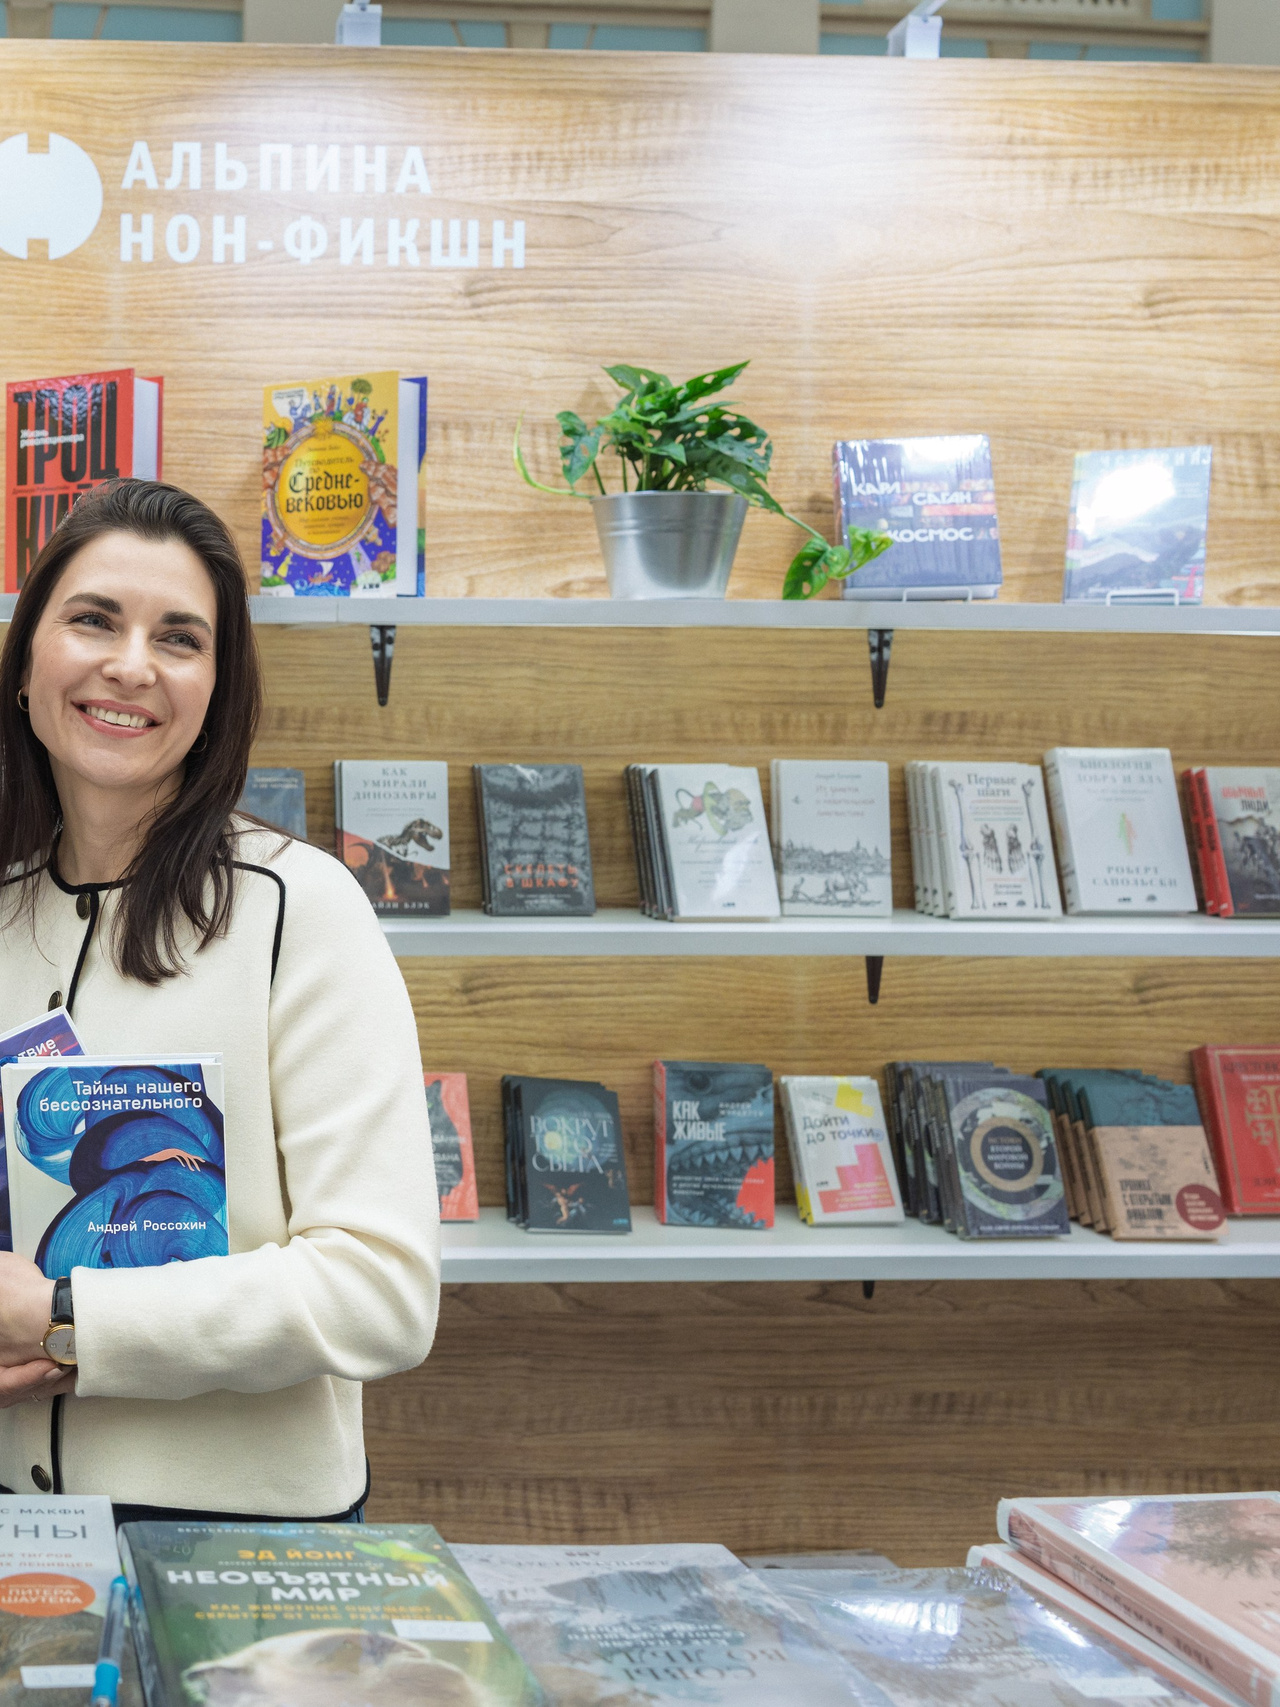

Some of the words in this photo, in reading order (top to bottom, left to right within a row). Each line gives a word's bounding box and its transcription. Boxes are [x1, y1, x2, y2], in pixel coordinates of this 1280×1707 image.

[121, 141, 433, 194] АЛЬПИНА
[120, 212, 526, 268] НОН-ФИКШН
[13, 381, 120, 486] ТРОЦ
[289, 470, 360, 495] Средне-
[851, 481, 901, 497] КАРЛ
[286, 493, 363, 513] вековью
[912, 490, 972, 506] САГАН
[887, 527, 974, 543] КОСМОС
[382, 768, 407, 776] КАК
[967, 773, 1017, 786] Первые
[363, 780, 427, 788] УМИРАЛИ
[353, 791, 437, 801] ДИНОЗАВРЫ
[977, 788, 1011, 797] шаги
[504, 864, 578, 875] СКЕЛЕТЫ
[521, 878, 579, 888] ШКАФУ
[73, 1079, 128, 1096] Тайны
[136, 1080, 202, 1095] нашего
[39, 1096, 203, 1112] бессознательного
[672, 1100, 701, 1120] КАК
[529, 1115, 614, 1141] ВОКРУГ
[803, 1113, 850, 1131] Дойти
[672, 1121, 727, 1141] ЖИВЫЕ
[806, 1131, 825, 1145] до
[829, 1128, 874, 1140] точки
[531, 1152, 604, 1175] СВЕТА
[87, 1220, 137, 1234] Андрей
[143, 1220, 207, 1232] Россохин
[237, 1550, 277, 1561] ЭД
[285, 1547, 356, 1561] ЙОНГ
[166, 1569, 451, 1588] НЕОБЪЯТНЫЙ
[0, 1596, 83, 1604] ШАУТЕНА
[8, 1588, 75, 1597] ПИТЕРА
[271, 1586, 362, 1602] МИР
[194, 1611, 277, 1620] СКРЫТУЮ
[282, 1612, 303, 1620] ОТ
[310, 1612, 342, 1620] НАС
[349, 1612, 456, 1621] РЕАЛЬНОСТЬ
[209, 1603, 242, 1612] КАК
[248, 1604, 339, 1612] ЖИВОТНЫЕ
[344, 1604, 432, 1614] ОЩУЩАЮТ
[569, 1649, 704, 1664] ЛЬДАХ
[725, 1649, 788, 1661] ВО
[622, 1666, 757, 1681] СОВЫ
